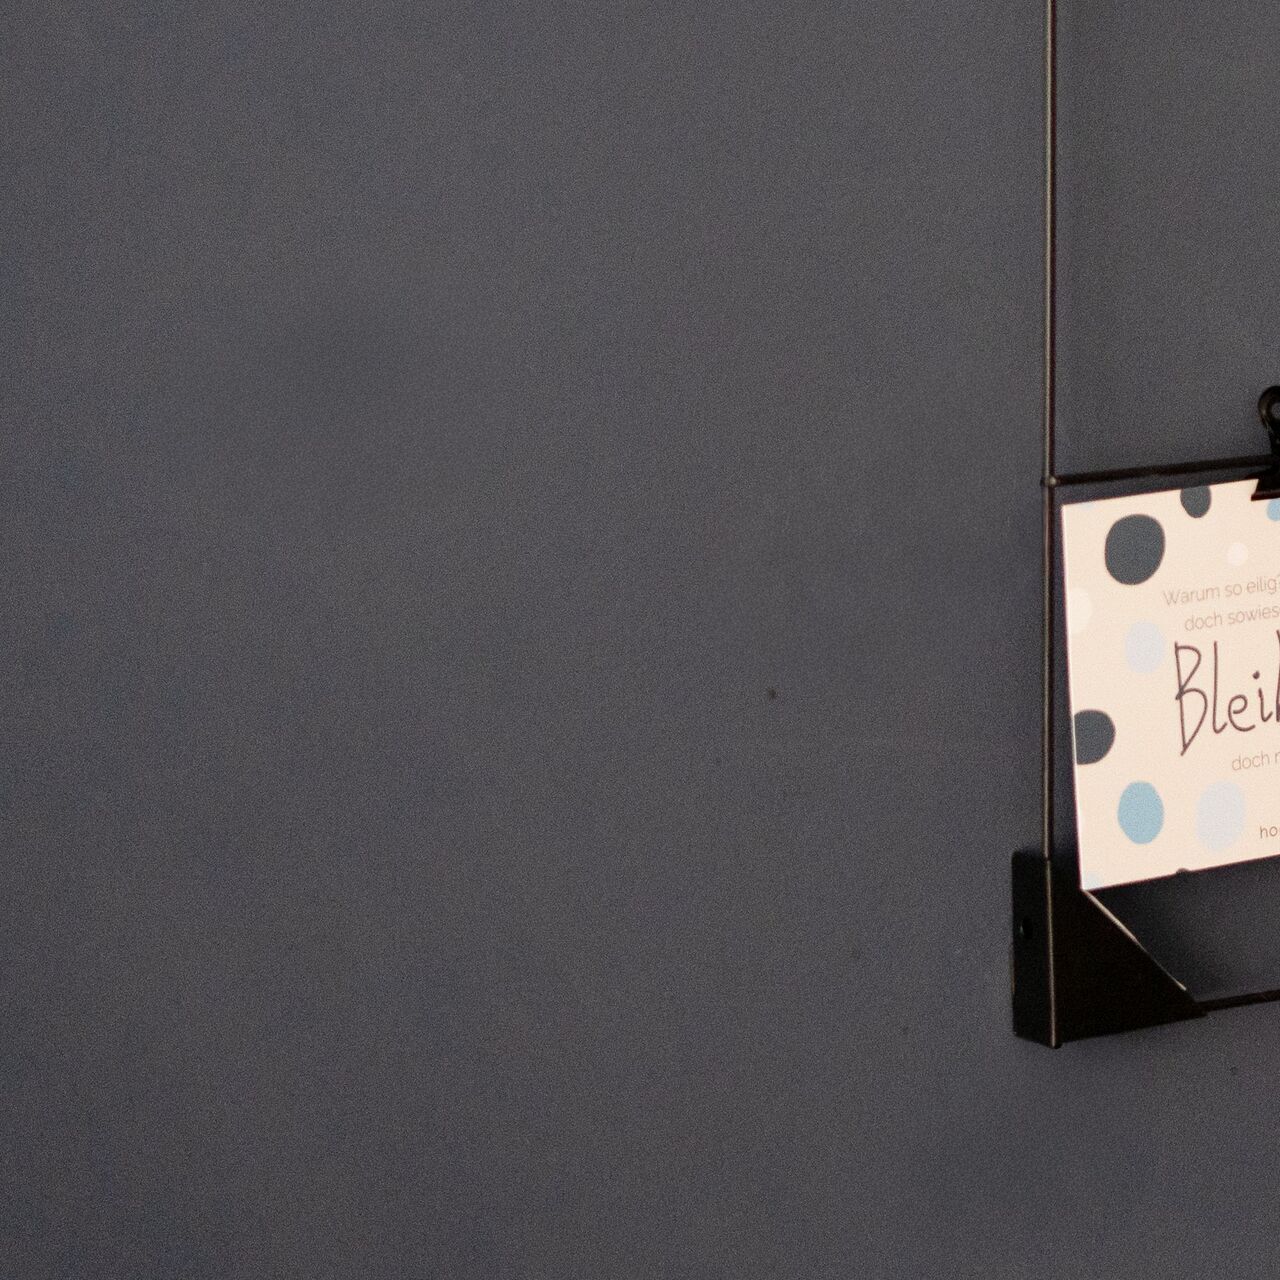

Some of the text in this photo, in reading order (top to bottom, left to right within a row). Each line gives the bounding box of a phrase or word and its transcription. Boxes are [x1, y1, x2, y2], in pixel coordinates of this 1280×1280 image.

[1162, 584, 1221, 606] Warum
[1224, 583, 1243, 598] so
[1184, 611, 1223, 632] doch
[1231, 750, 1270, 771] doch
